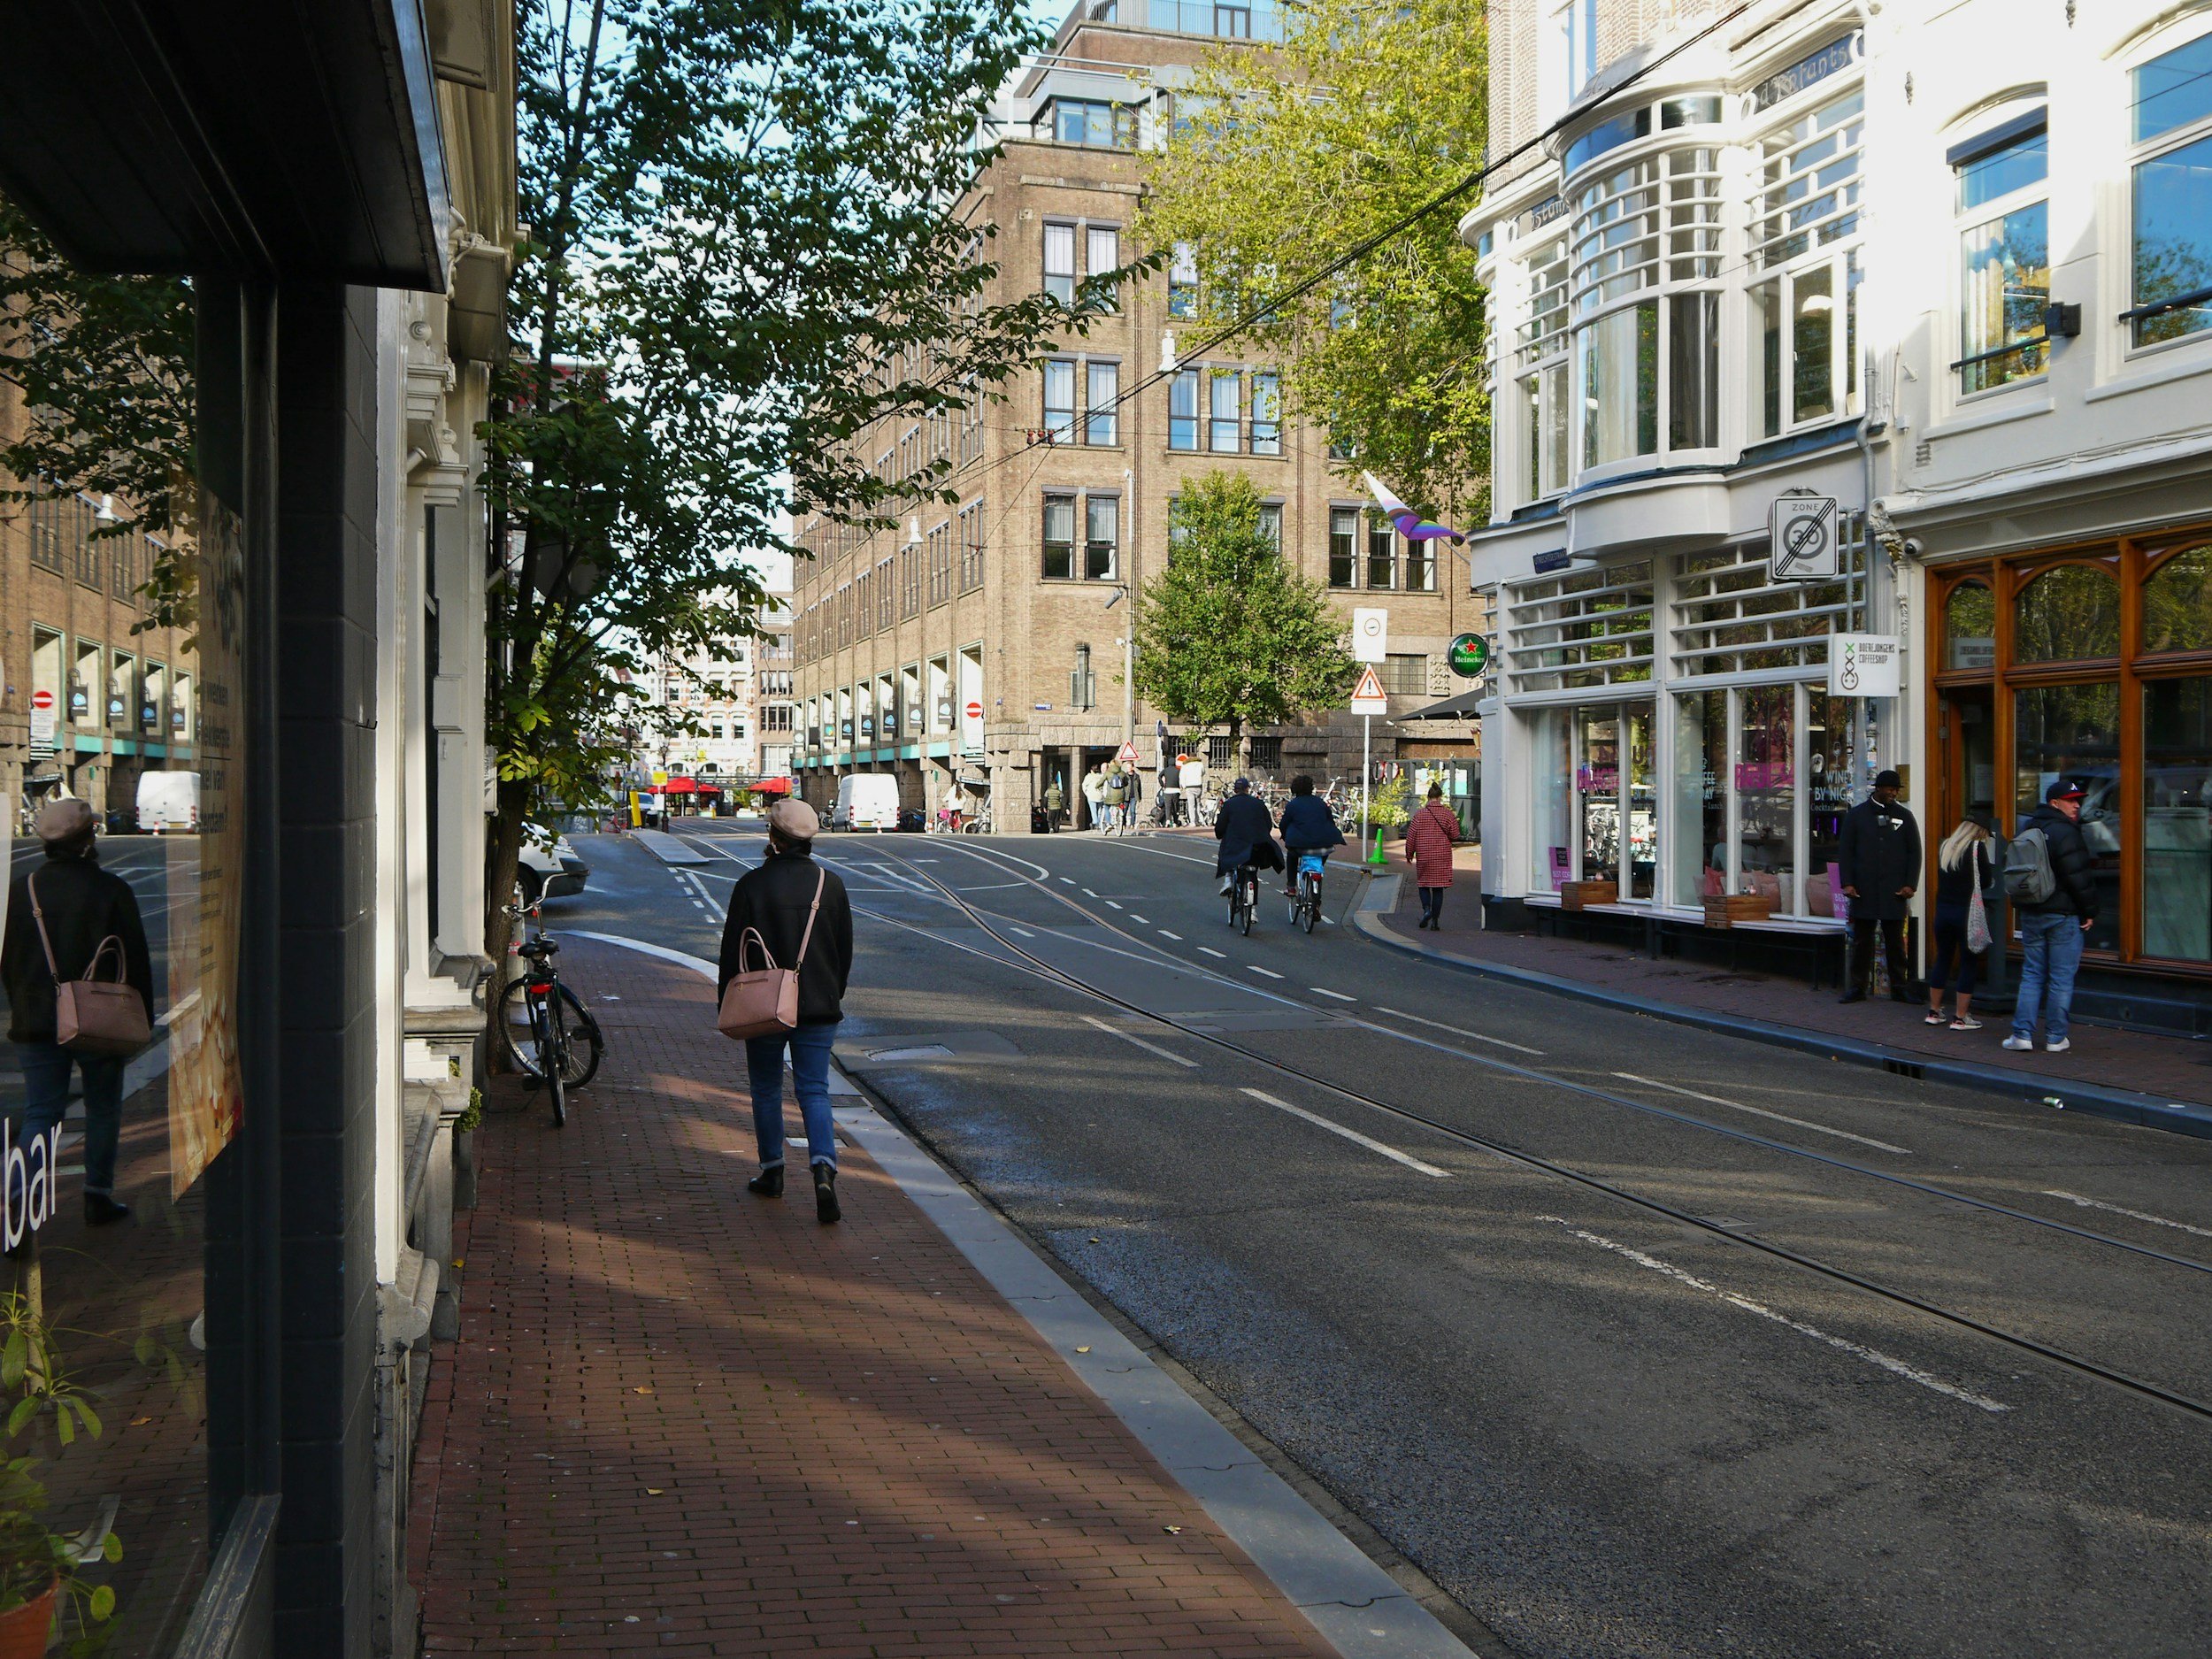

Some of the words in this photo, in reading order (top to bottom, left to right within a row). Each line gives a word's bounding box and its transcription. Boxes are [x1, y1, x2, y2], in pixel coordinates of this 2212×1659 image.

[1792, 529, 1820, 545] 30
[1859, 643, 1895, 653] BOEREJONGENS
[1859, 655, 1888, 664] COFFEESHOP
[1815, 787, 1826, 802] BY
[4, 1117, 62, 1253] bar
